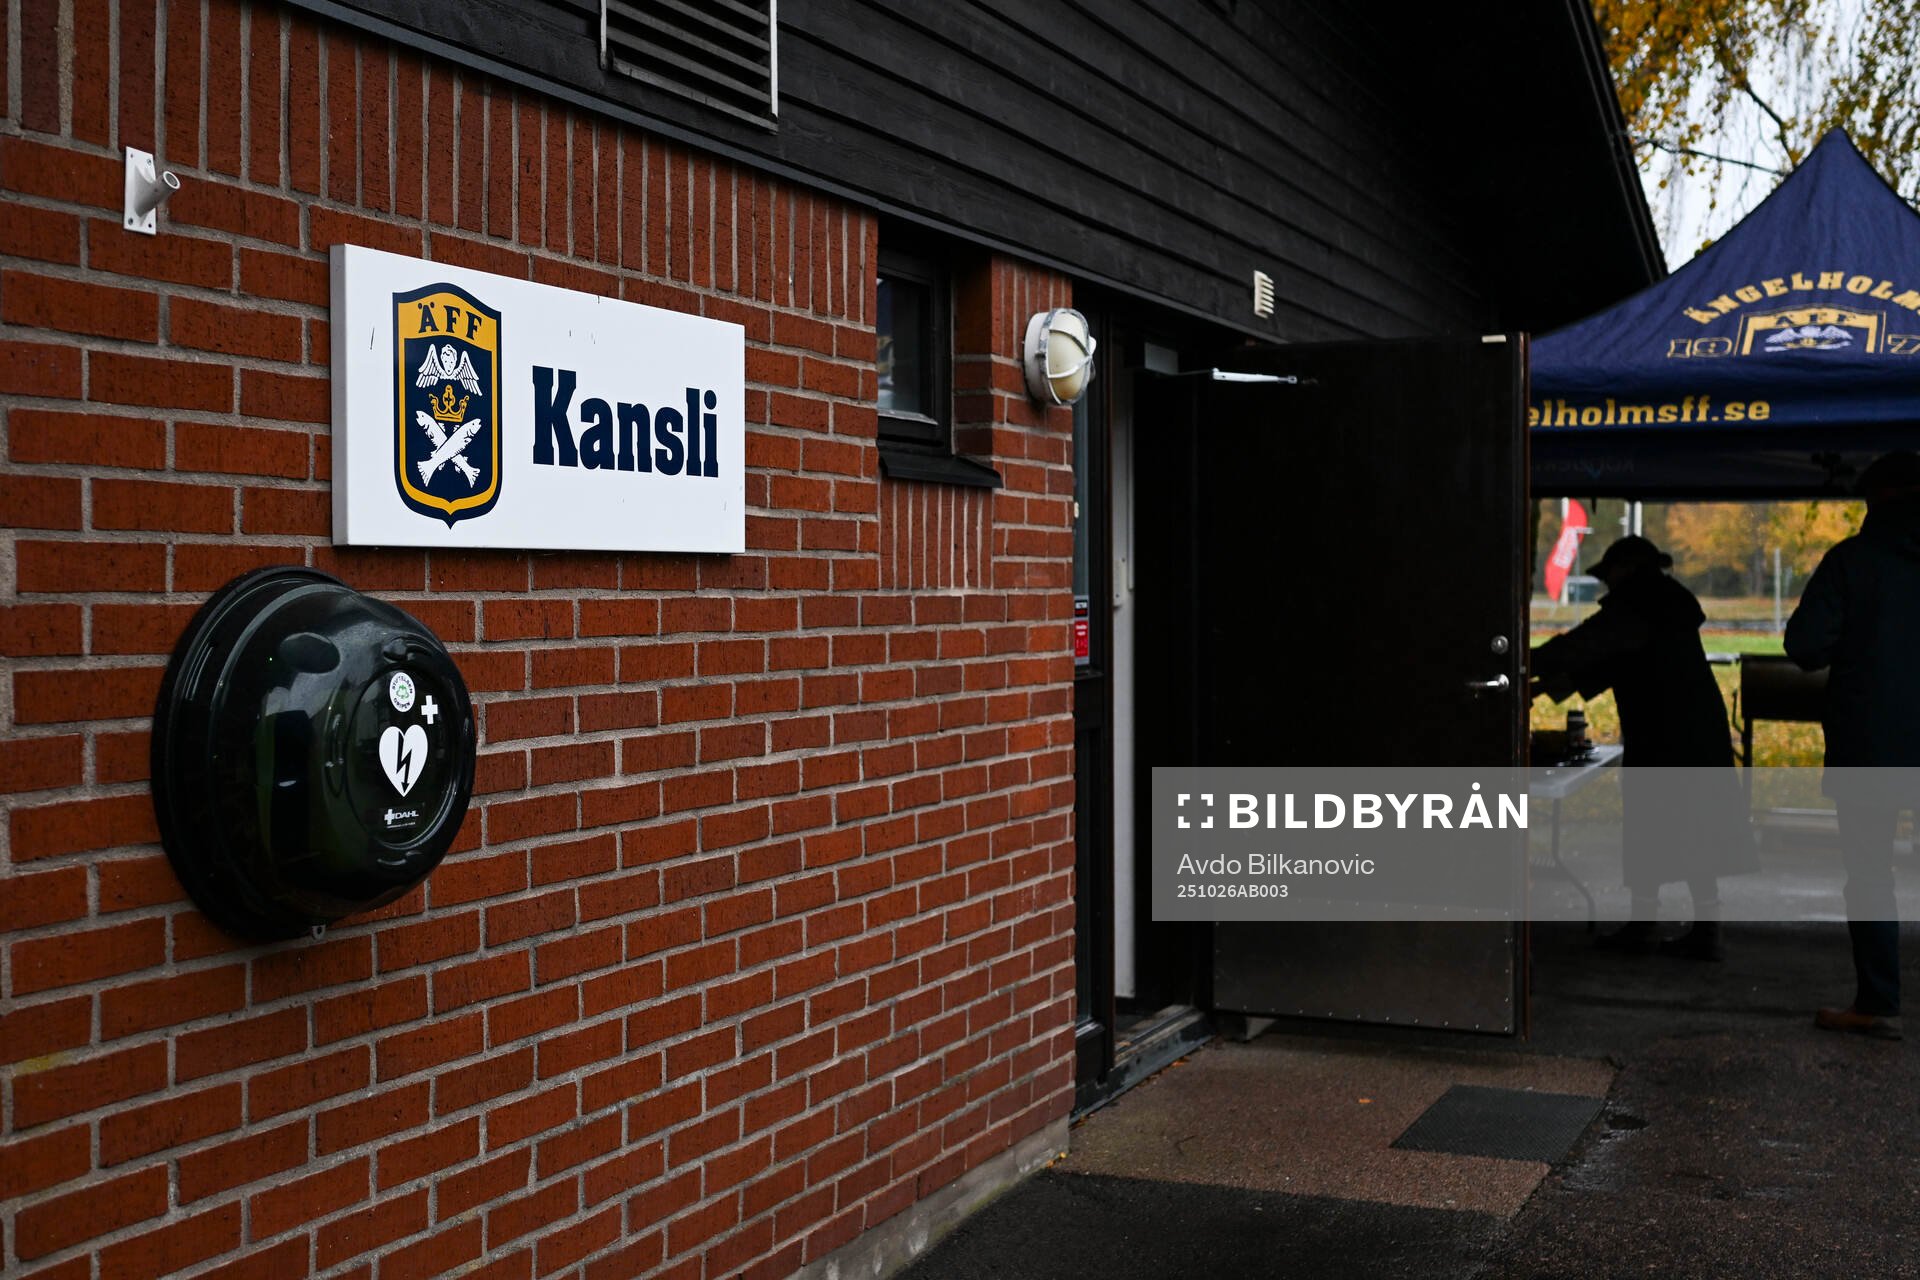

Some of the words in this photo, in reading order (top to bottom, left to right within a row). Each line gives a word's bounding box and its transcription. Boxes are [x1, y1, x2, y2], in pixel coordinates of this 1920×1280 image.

[1683, 271, 1920, 324] ÄNGELHOLM
[417, 302, 482, 340] ÄFF
[532, 365, 719, 478] Kansli
[395, 810, 419, 820] DAHL
